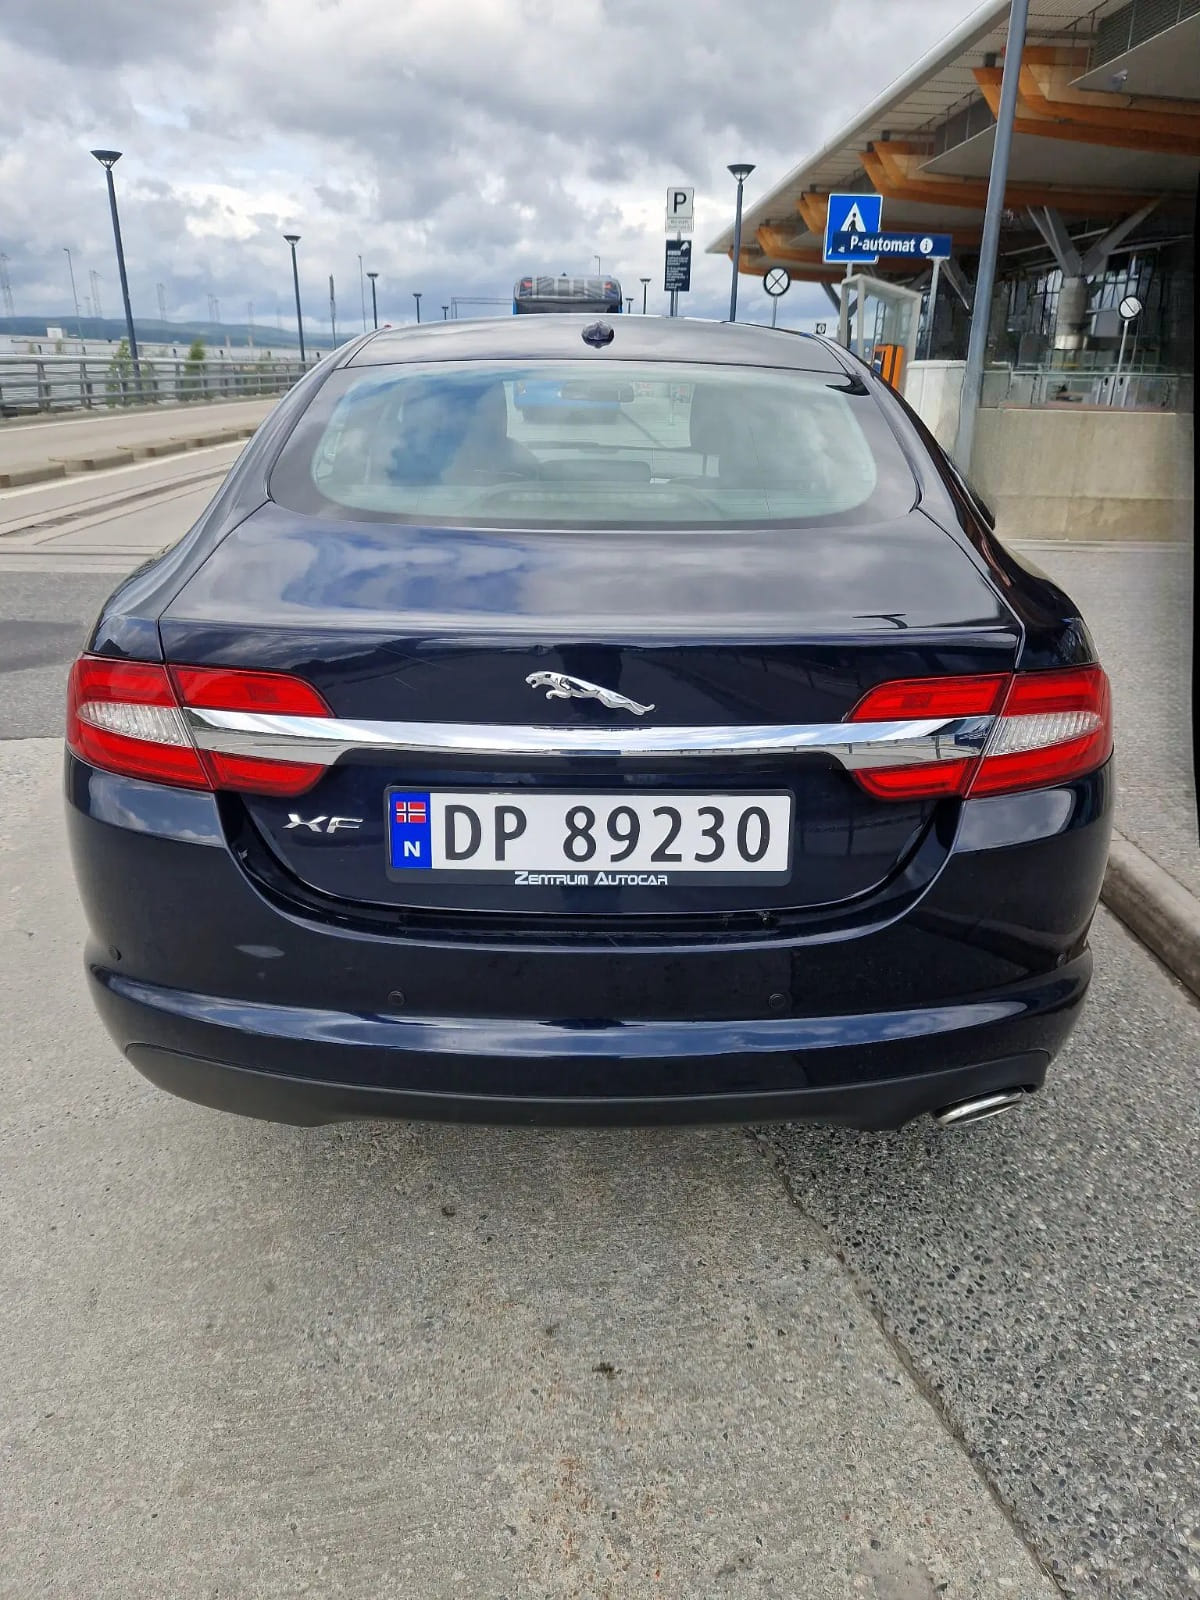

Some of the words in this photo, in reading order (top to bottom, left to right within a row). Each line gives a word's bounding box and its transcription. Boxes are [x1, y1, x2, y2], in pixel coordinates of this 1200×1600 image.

[673, 191, 687, 214] P
[850, 235, 915, 252] P-automat
[283, 812, 363, 833] XF
[445, 805, 527, 861] DP
[563, 805, 771, 863] 89230
[404, 841, 420, 857] N
